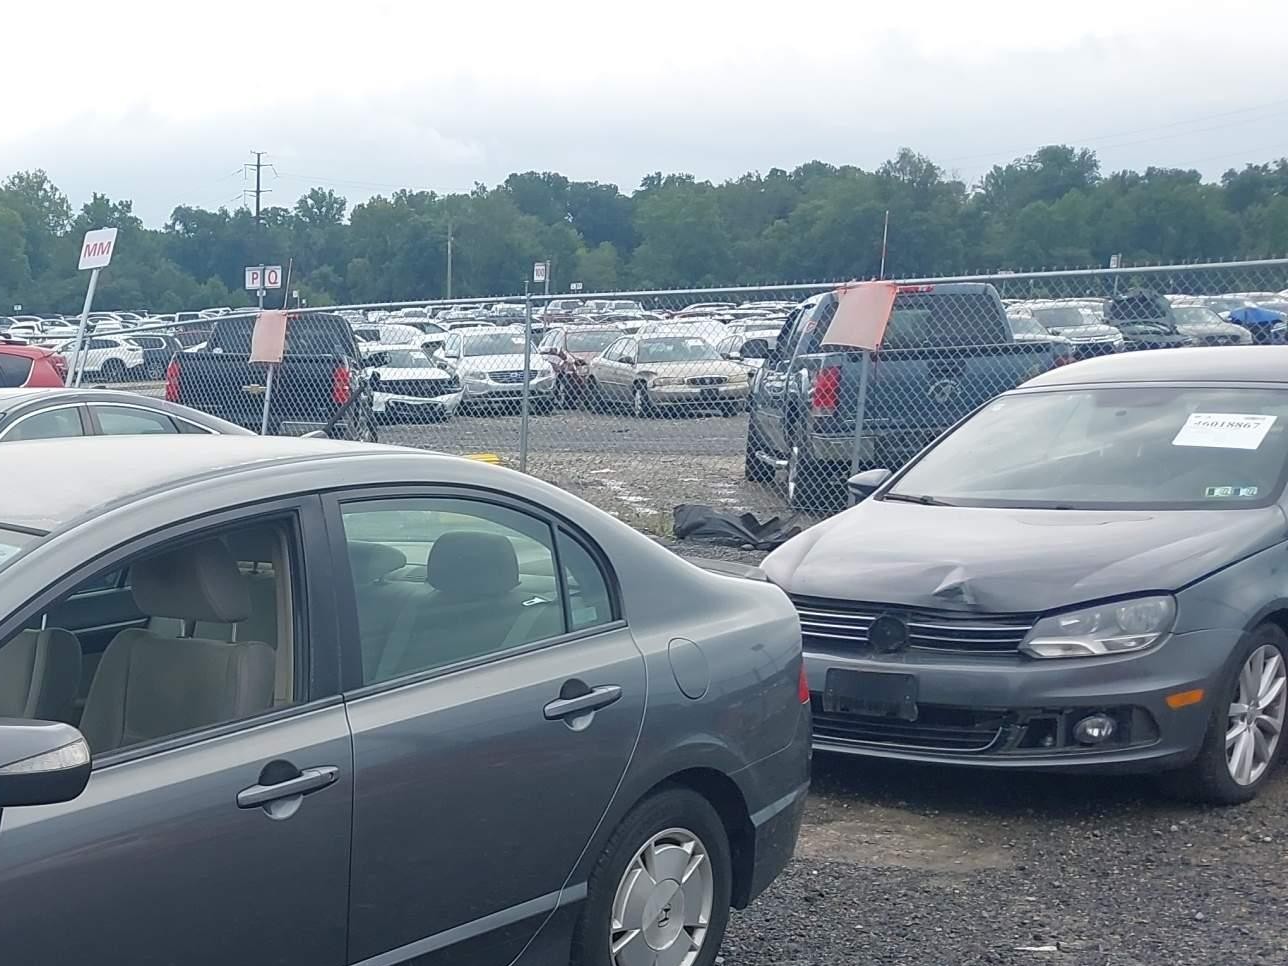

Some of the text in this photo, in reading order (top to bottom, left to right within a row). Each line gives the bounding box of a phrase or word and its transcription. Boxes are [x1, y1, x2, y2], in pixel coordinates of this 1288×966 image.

[83, 241, 112, 258] MM
[251, 271, 259, 285] P
[268, 270, 279, 285] Q
